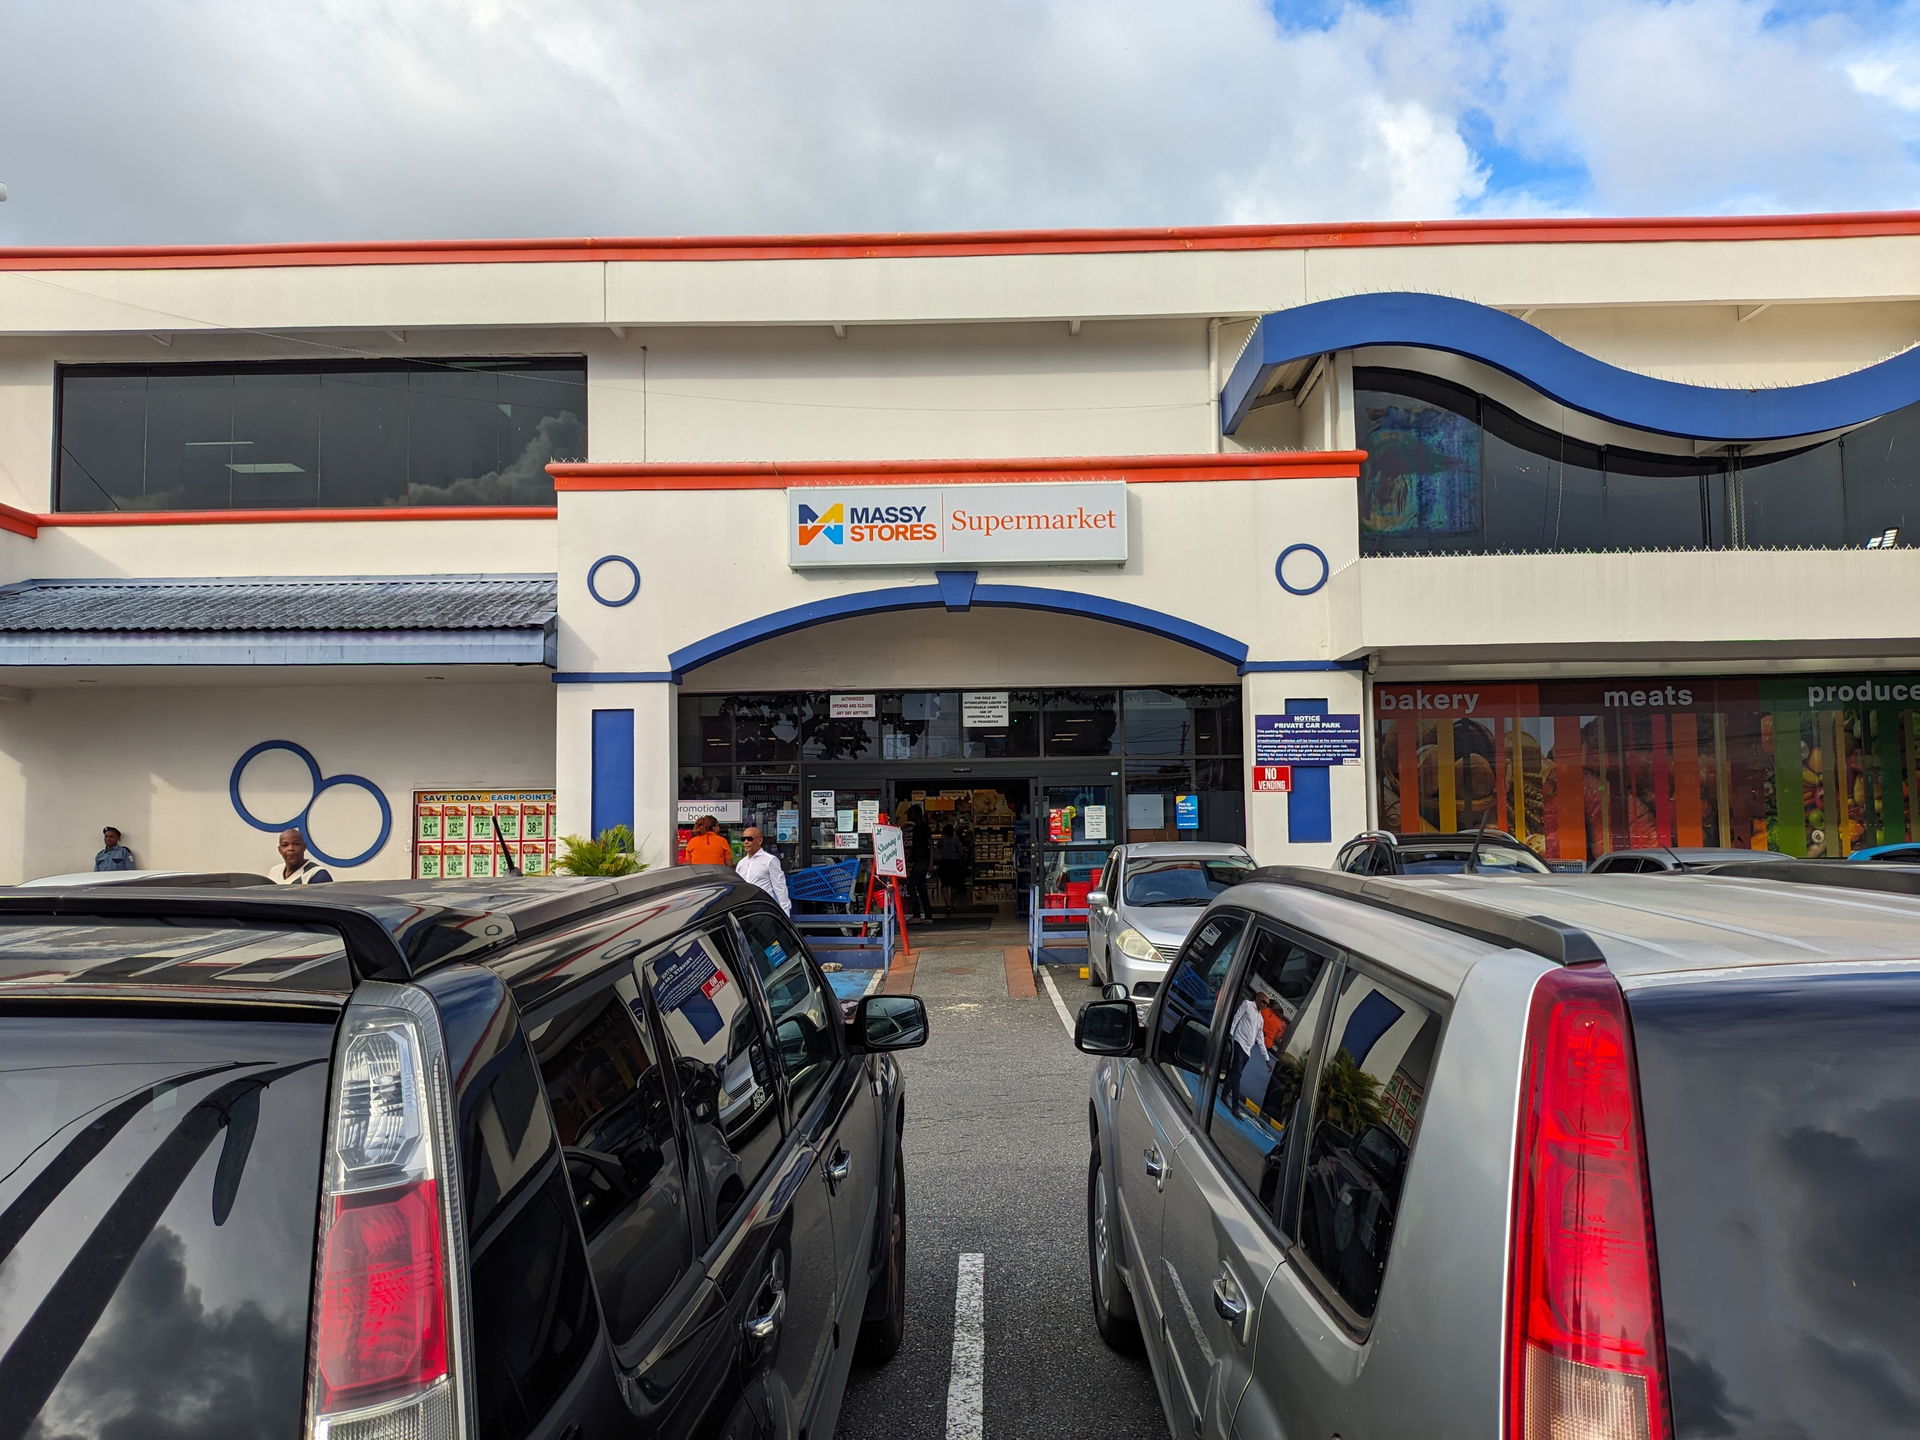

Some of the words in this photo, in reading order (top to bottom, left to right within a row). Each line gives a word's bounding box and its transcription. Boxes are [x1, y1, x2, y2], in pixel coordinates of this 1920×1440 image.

[850, 506, 927, 524] MASSY
[952, 507, 1116, 536] Supermarket
[850, 524, 936, 542] STORES
[1380, 690, 1480, 713] bakery
[1604, 686, 1692, 706] meats
[1808, 680, 1920, 706] produce
[1265, 768, 1277, 780] NO
[1258, 781, 1286, 789] VENDING
[677, 804, 727, 812] romotional
